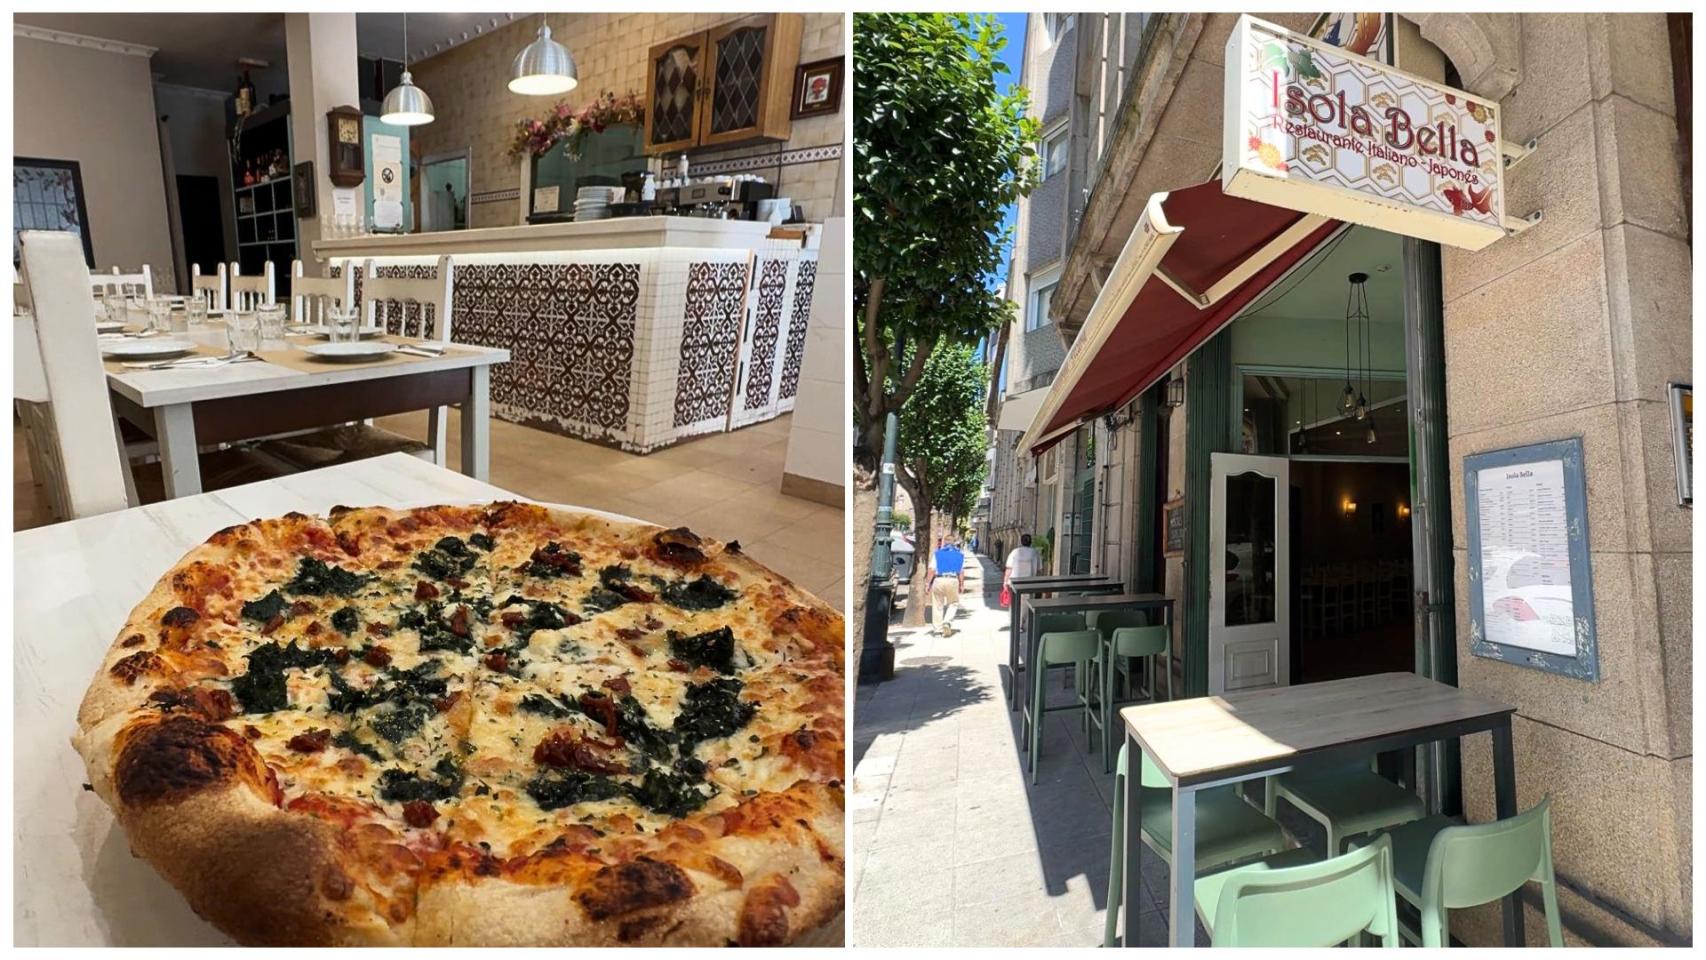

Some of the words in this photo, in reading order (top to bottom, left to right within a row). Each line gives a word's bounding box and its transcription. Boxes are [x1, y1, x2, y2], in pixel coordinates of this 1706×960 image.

[1272, 70, 1374, 136] Isola
[1385, 107, 1480, 168] Bella
[1272, 113, 1364, 153] Restaurante
[1368, 141, 1418, 168] Italiano
[1428, 159, 1480, 185] Japonés
